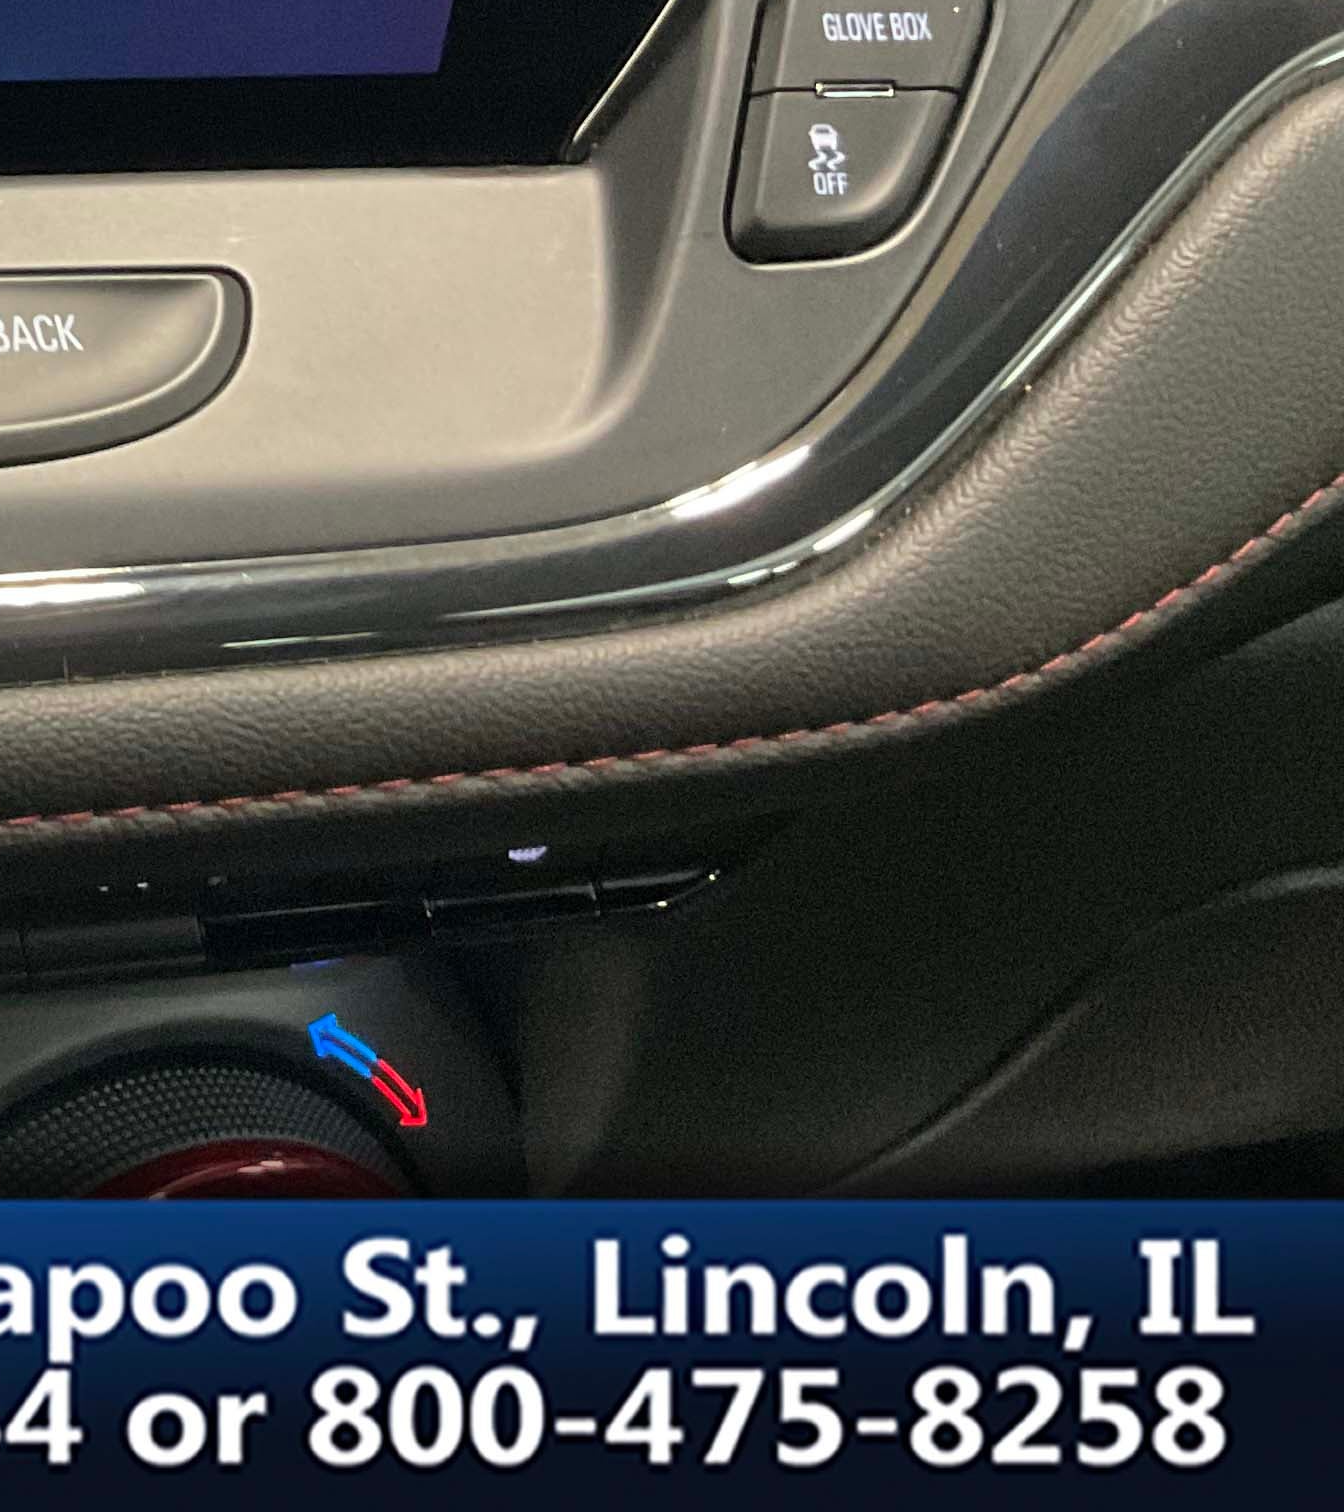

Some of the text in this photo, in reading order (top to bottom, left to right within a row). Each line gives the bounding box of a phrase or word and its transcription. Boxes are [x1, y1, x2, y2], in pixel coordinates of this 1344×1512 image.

[822, 12, 932, 41] GLOVE BOX
[812, 172, 848, 196] OFF
